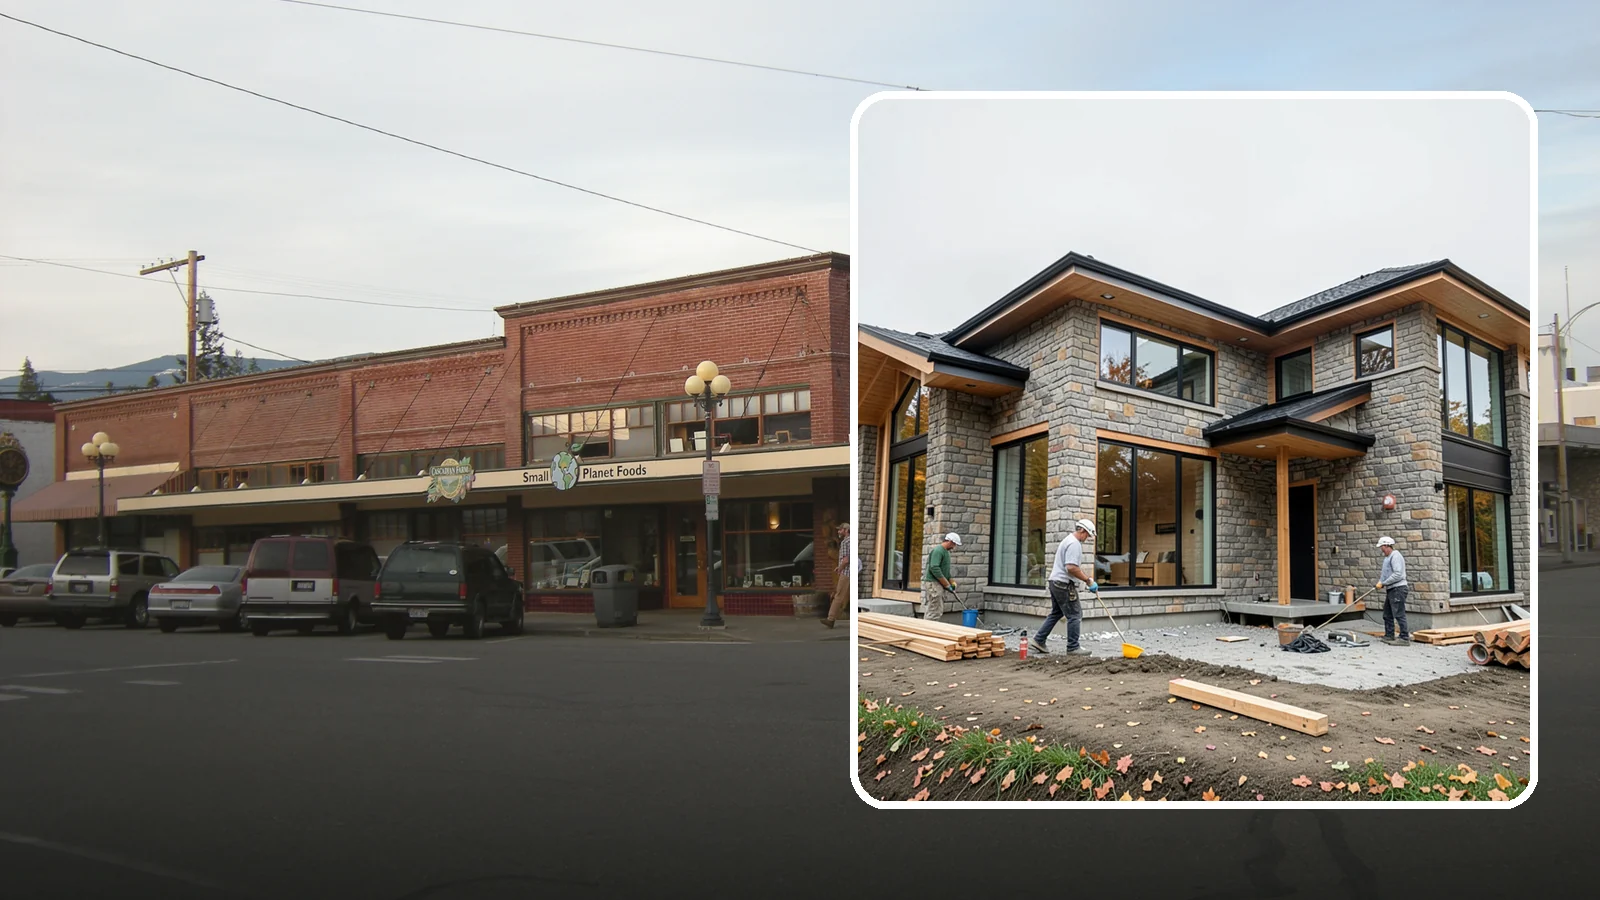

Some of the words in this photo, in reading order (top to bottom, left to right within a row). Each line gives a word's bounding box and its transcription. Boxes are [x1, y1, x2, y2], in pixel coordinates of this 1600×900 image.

[523, 471, 549, 483] Small
[582, 467, 614, 479] Planet
[616, 464, 647, 477] Foods
